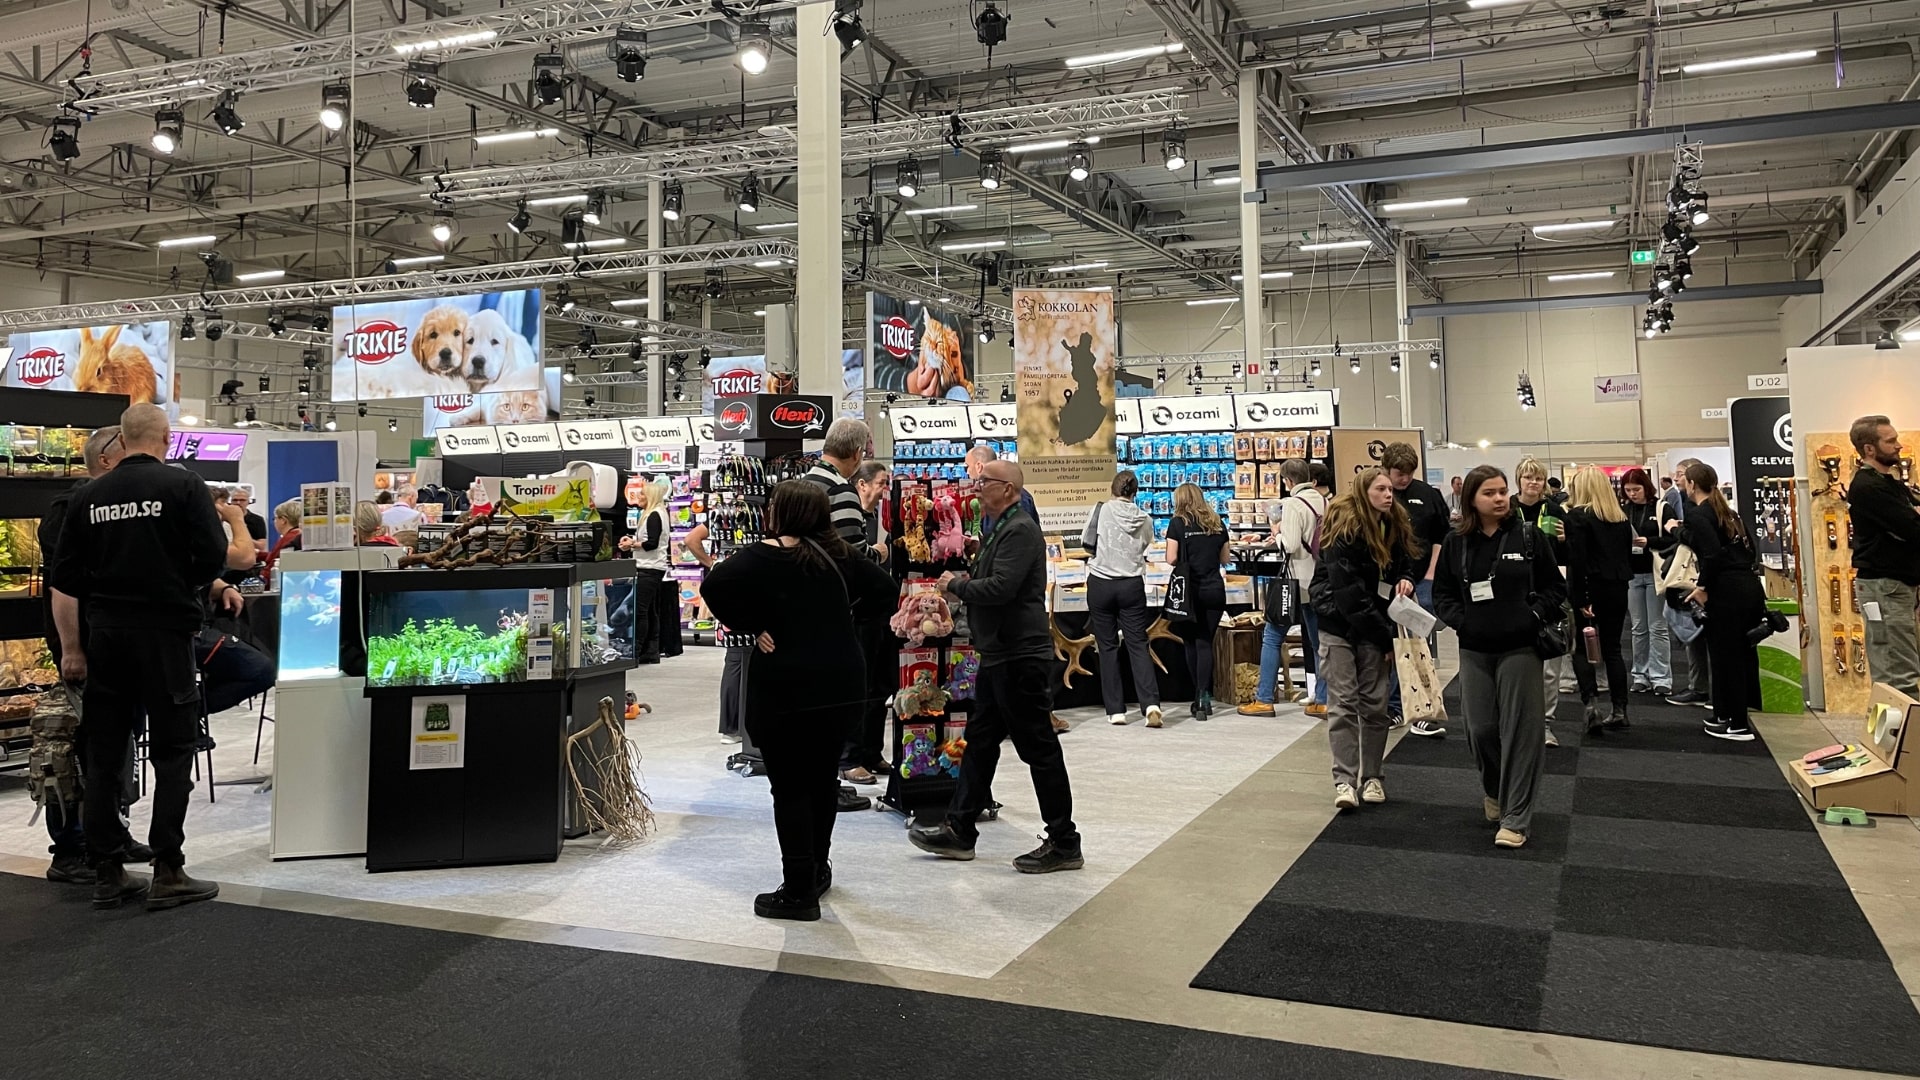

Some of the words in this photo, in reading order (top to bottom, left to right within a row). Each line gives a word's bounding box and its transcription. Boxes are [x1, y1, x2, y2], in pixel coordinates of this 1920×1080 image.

[1038, 302, 1098, 312] KOKKOLAN
[344, 326, 407, 358] TRIXIE
[880, 323, 915, 351] TRIXIE
[16, 353, 65, 380] TRIXIE
[711, 374, 762, 396] TRIXIE
[1755, 377, 1781, 387] D:02
[722, 406, 747, 424] flexi
[775, 406, 815, 423] flexi
[1177, 407, 1220, 420] ozami
[1272, 402, 1319, 417] ozami
[919, 416, 957, 428] ozami
[520, 432, 551, 444] ozami
[583, 428, 614, 441] ozami
[649, 426, 682, 438] ozami
[461, 434, 490, 446] ozami
[636, 450, 681, 466] hound
[513, 484, 557, 497] Tropifit
[90, 500, 163, 525] imazo.se
